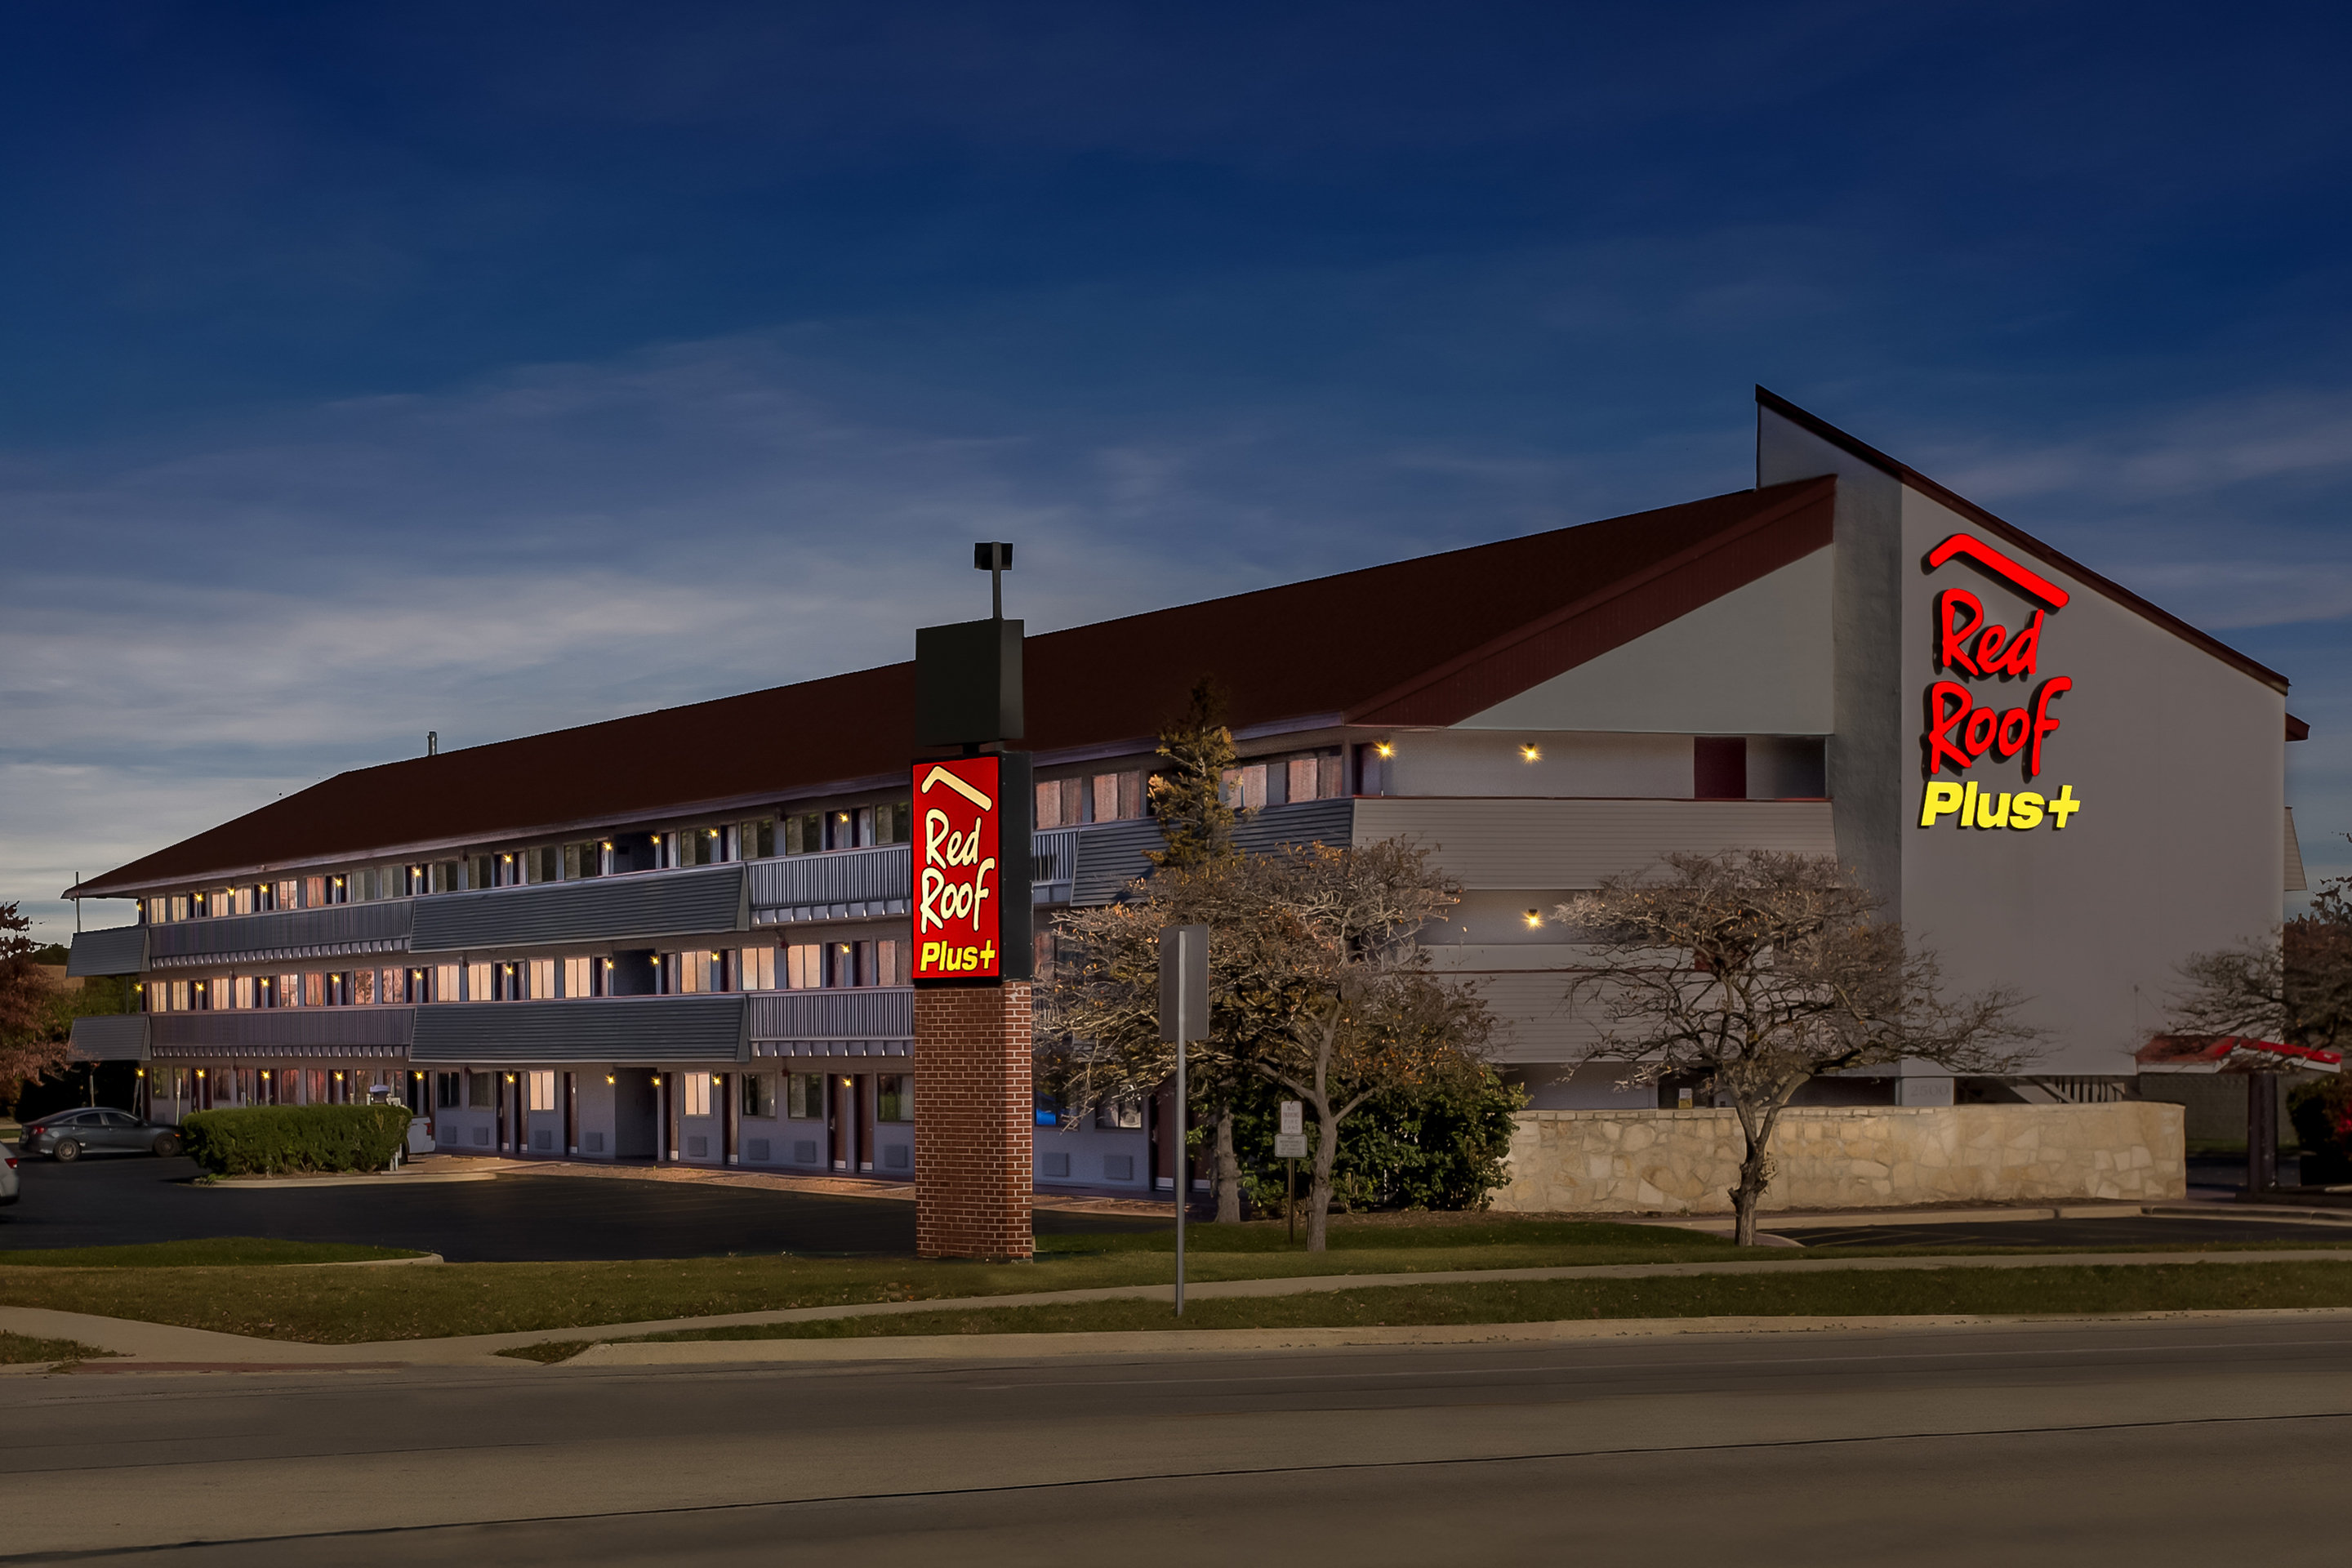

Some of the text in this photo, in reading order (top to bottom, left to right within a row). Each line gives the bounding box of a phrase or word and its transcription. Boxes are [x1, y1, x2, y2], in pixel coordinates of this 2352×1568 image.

[1940, 587, 2045, 676] Red
[1928, 675, 2073, 777] Roof
[1920, 781, 2081, 830] Plus+
[924, 808, 982, 870] Red
[920, 858, 996, 934] Roof
[920, 939, 996, 972] Plus+
[1910, 1084, 1949, 1097] 2500
